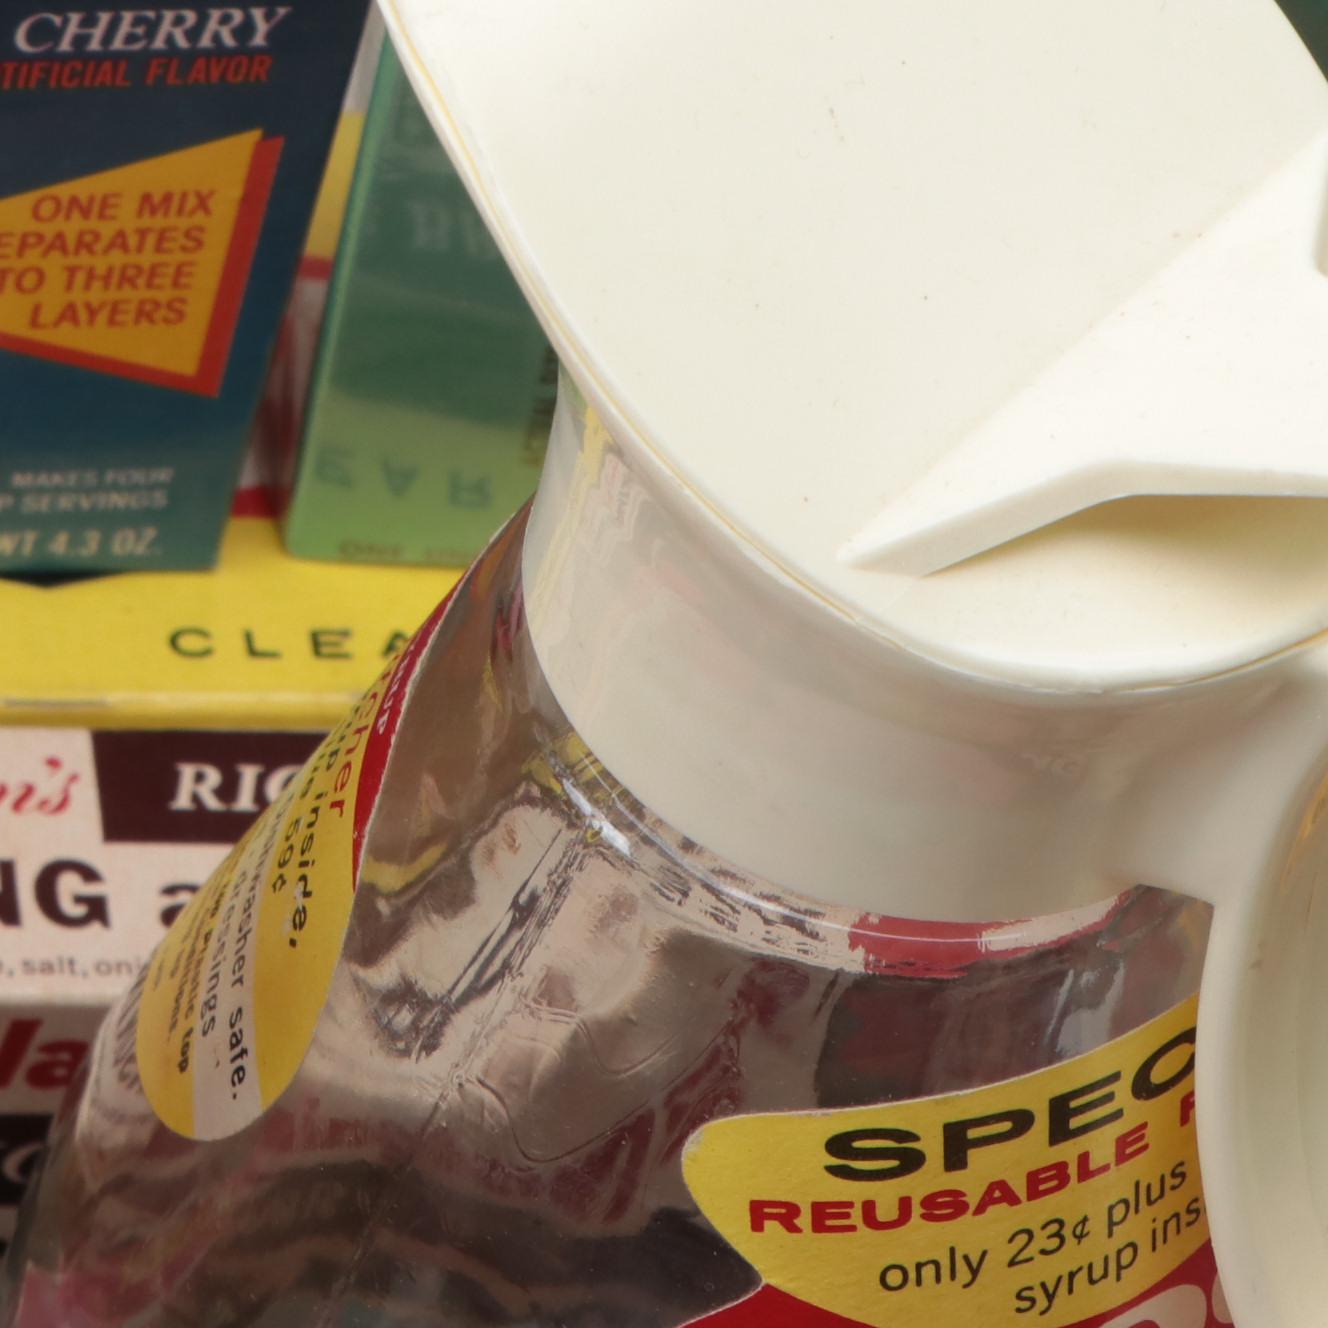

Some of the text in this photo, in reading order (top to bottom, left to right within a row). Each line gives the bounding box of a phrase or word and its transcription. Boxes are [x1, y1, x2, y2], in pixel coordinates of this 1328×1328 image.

[13, 5, 293, 54] CHERRY
[145, 55, 274, 86] FLAVOR
[31, 189, 217, 223] ONE MIX
[62, 260, 197, 294] THREE
[28, 297, 189, 331] LAYERS
[20, 488, 169, 513] SERVINGS
[22, 956, 91, 980] salt,
[225, 1005, 249, 1102] safe.
[748, 1121, 1149, 1234] REUSABLE
[879, 1160, 1188, 1292] only 23¢ plus
[1015, 1241, 1140, 1315] syrup
[1150, 1197, 1206, 1254] ins
